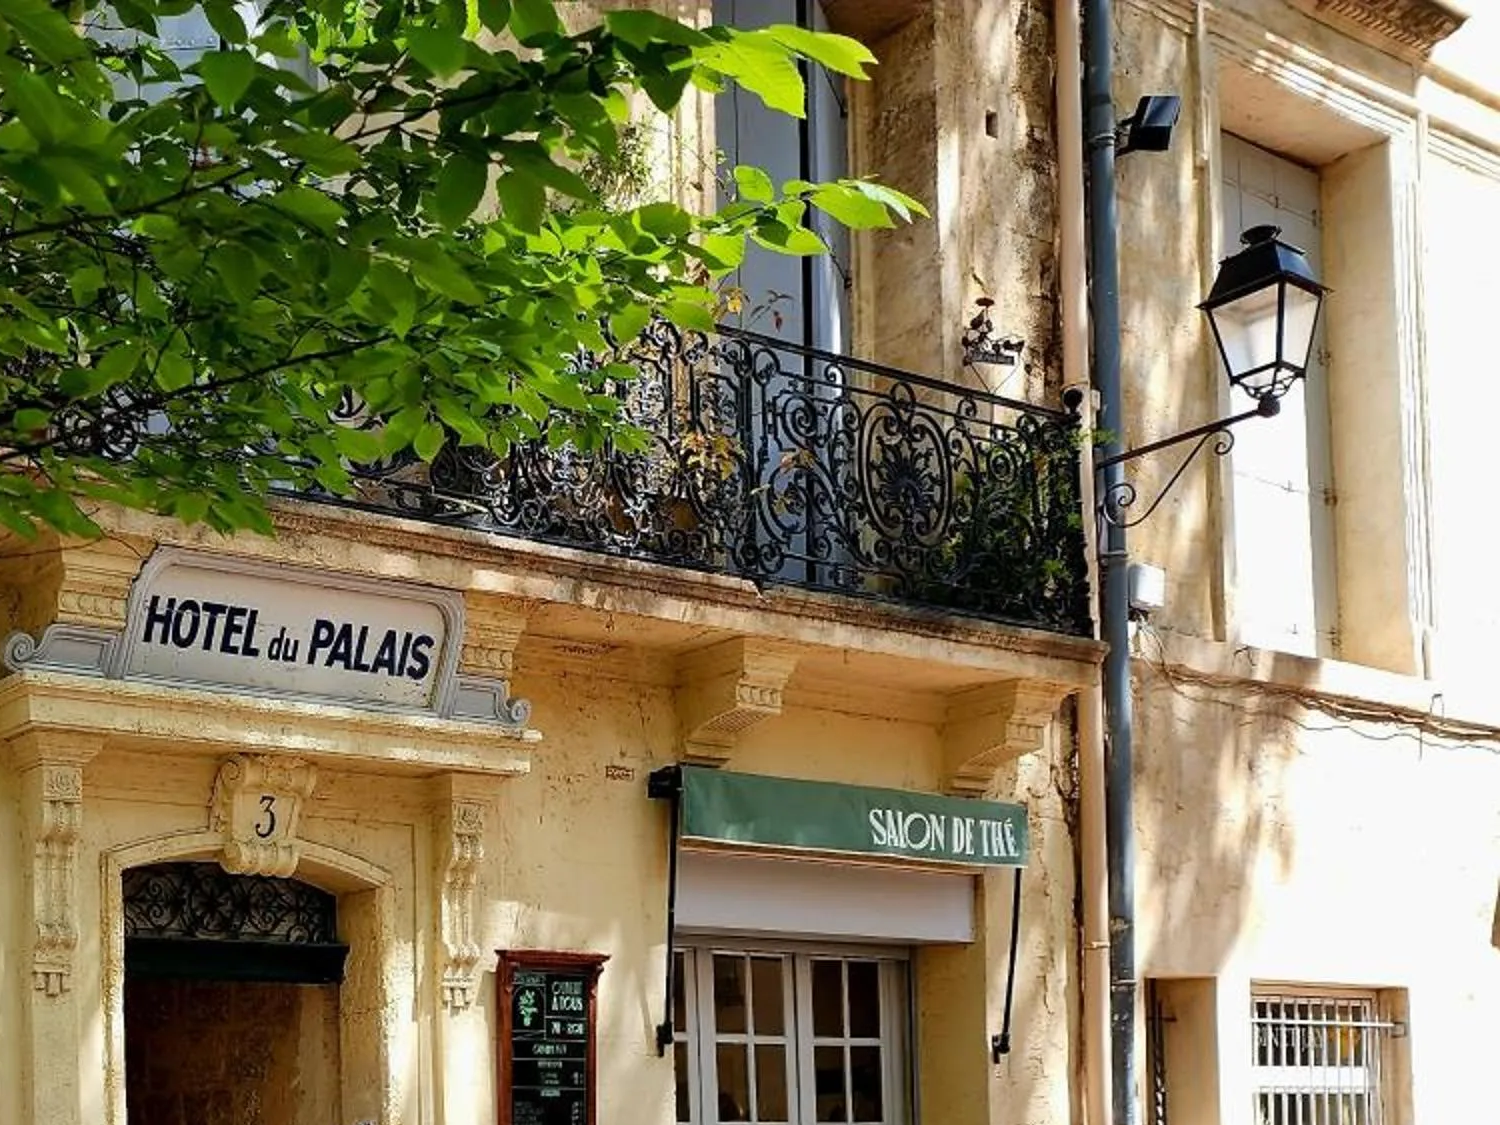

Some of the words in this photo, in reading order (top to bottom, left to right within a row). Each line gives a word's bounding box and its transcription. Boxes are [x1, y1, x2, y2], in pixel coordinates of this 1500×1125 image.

[142, 595, 260, 657] HOTEL
[267, 627, 299, 662] du
[307, 619, 435, 680] PALAIS
[255, 795, 277, 839] 3
[868, 808, 946, 851] SALON
[952, 817, 976, 855] DE
[980, 817, 1021, 857] THÉ
